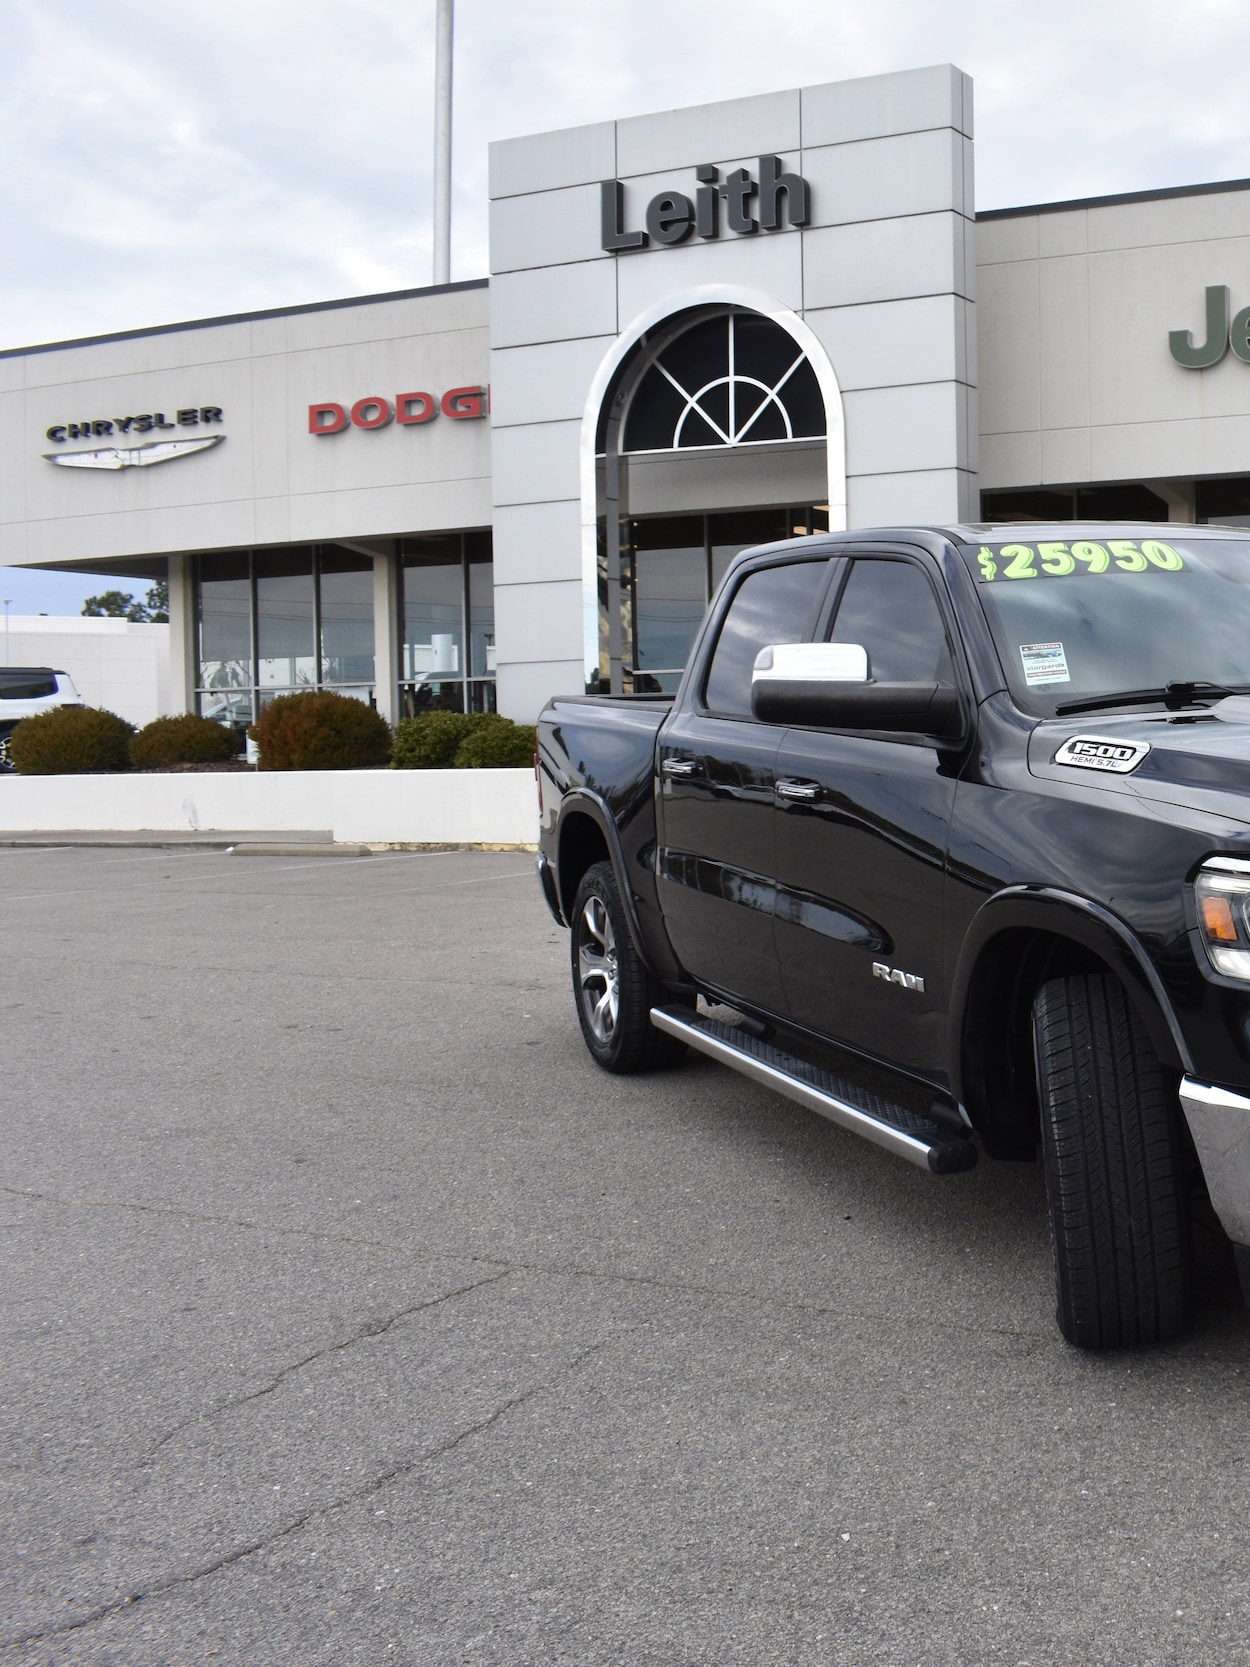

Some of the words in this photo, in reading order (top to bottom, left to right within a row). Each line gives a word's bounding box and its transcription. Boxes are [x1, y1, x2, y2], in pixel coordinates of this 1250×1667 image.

[600, 154, 811, 253] Leith
[46, 406, 223, 443] CHRYSLER
[308, 384, 491, 436] DODG
[977, 540, 1184, 581] $25950
[1070, 755, 1096, 764] HEMI
[1096, 758, 1118, 768] 5.7L
[1073, 741, 1134, 760] 1500
[872, 961, 925, 993] RAM
